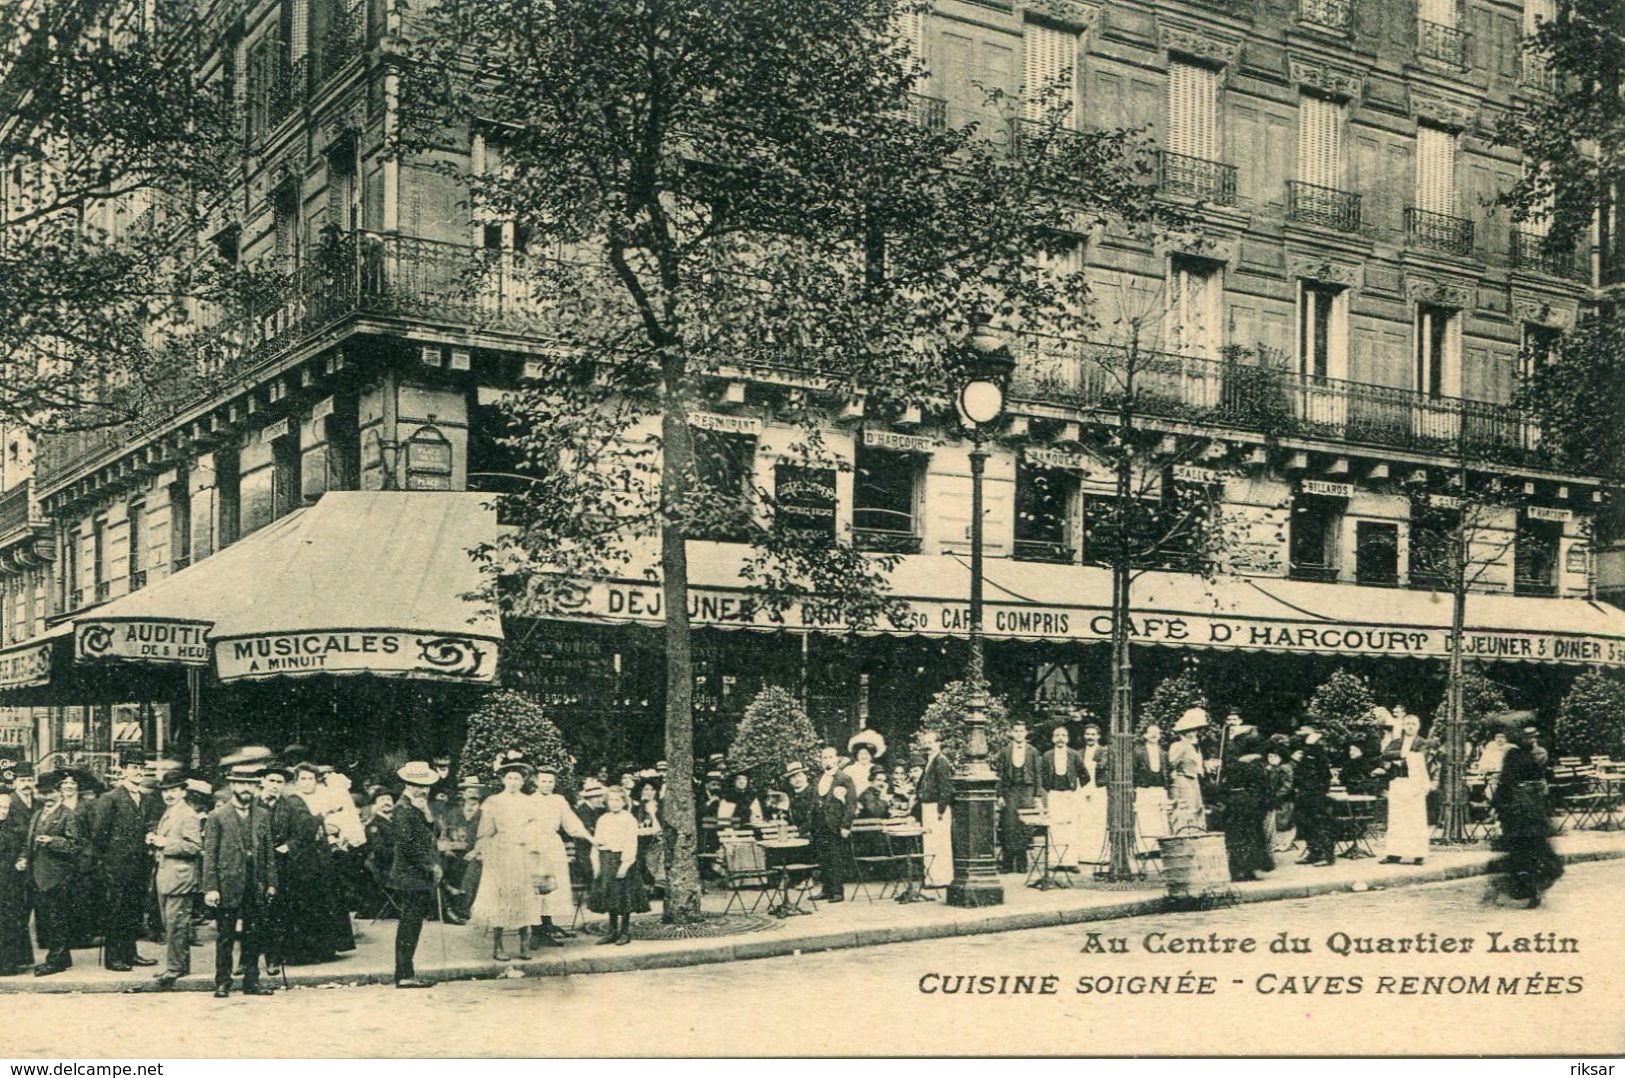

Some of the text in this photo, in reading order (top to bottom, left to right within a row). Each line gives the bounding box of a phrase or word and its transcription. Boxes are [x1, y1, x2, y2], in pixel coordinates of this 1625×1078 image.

[866, 432, 930, 450] D'HARCOURT
[1308, 482, 1348, 496] BILLARDS
[608, 589, 755, 623] DEJUNER
[941, 608, 978, 631] CAF
[996, 611, 1069, 634] COMPRIS
[1209, 622, 1429, 652] D'HARCOURT
[1554, 638, 1601, 659] DINER
[141, 644, 159, 656] DE
[233, 635, 400, 660] MUSICALES
[250, 655, 327, 672] A MINUIT
